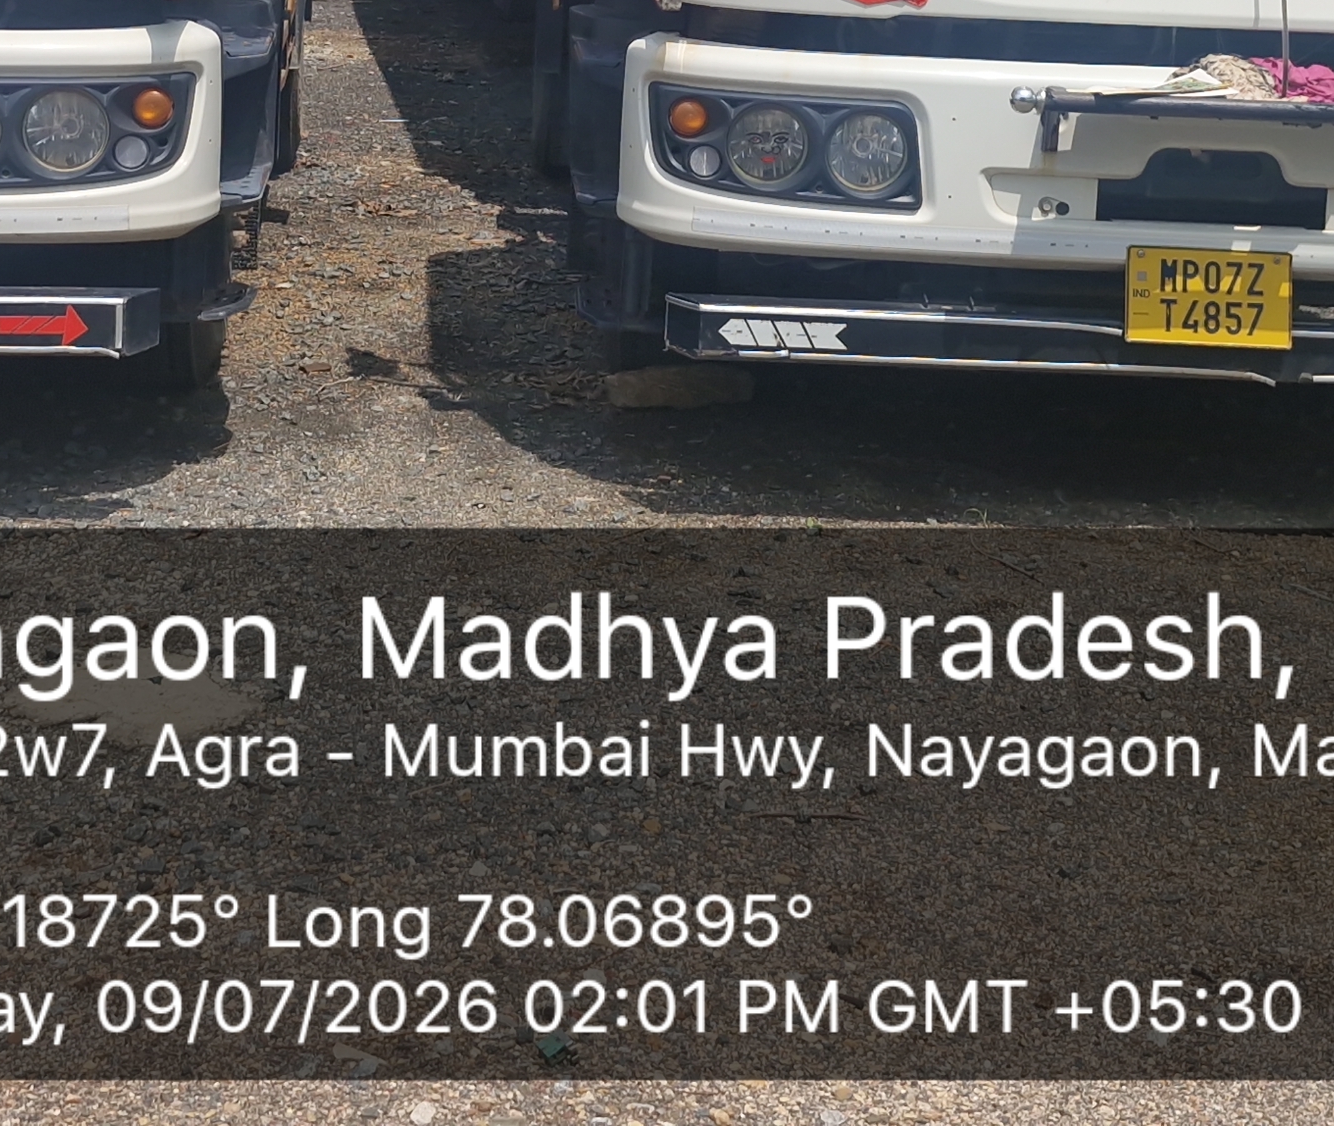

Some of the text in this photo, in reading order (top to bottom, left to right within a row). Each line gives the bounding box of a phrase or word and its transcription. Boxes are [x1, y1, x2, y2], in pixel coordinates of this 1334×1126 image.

[1132, 288, 1151, 298] IND
[1160, 258, 1265, 297] MP07Z
[1160, 298, 1265, 337] T4857
